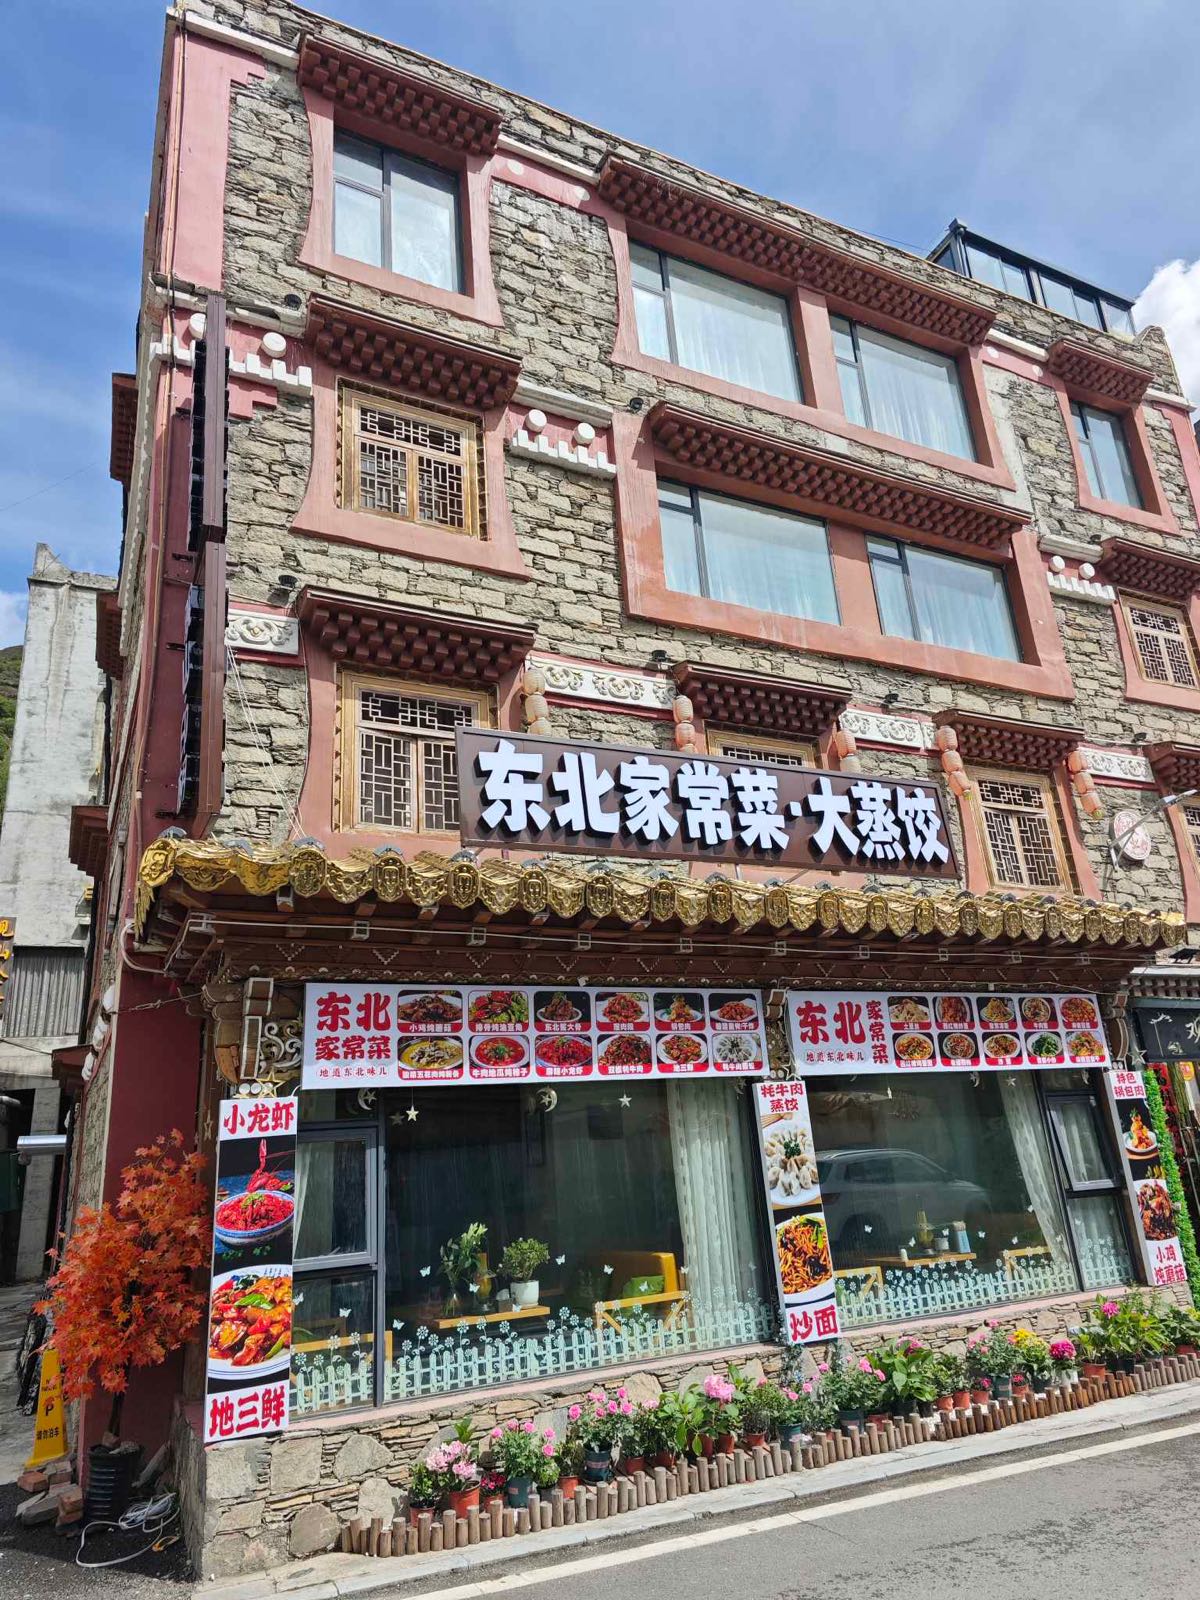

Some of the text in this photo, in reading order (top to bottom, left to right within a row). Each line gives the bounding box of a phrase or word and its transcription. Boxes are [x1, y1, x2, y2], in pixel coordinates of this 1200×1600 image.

[478, 738, 949, 865] 东北家常菜·大蒸饺
[316, 991, 391, 1032] 东北
[796, 1000, 866, 1045] 东北
[866, 1000, 888, 1064] 家常菜
[315, 1035, 391, 1061] 家常菜
[806, 1050, 865, 1063] 地道东北味儿
[319, 1066, 387, 1078] 地道东北味儿
[1116, 1072, 1137, 1084] 特色
[760, 1083, 803, 1098] 牦牛肉
[1113, 1085, 1145, 1097] 锅包肉
[769, 1098, 799, 1112] 蒸饺
[223, 1101, 295, 1135] 小龙虾
[1156, 1244, 1177, 1263] 小鸡
[1153, 1263, 1185, 1284] 炖蘑菇
[790, 1304, 838, 1342] 炒面
[208, 1385, 286, 1437] 地三鲜
